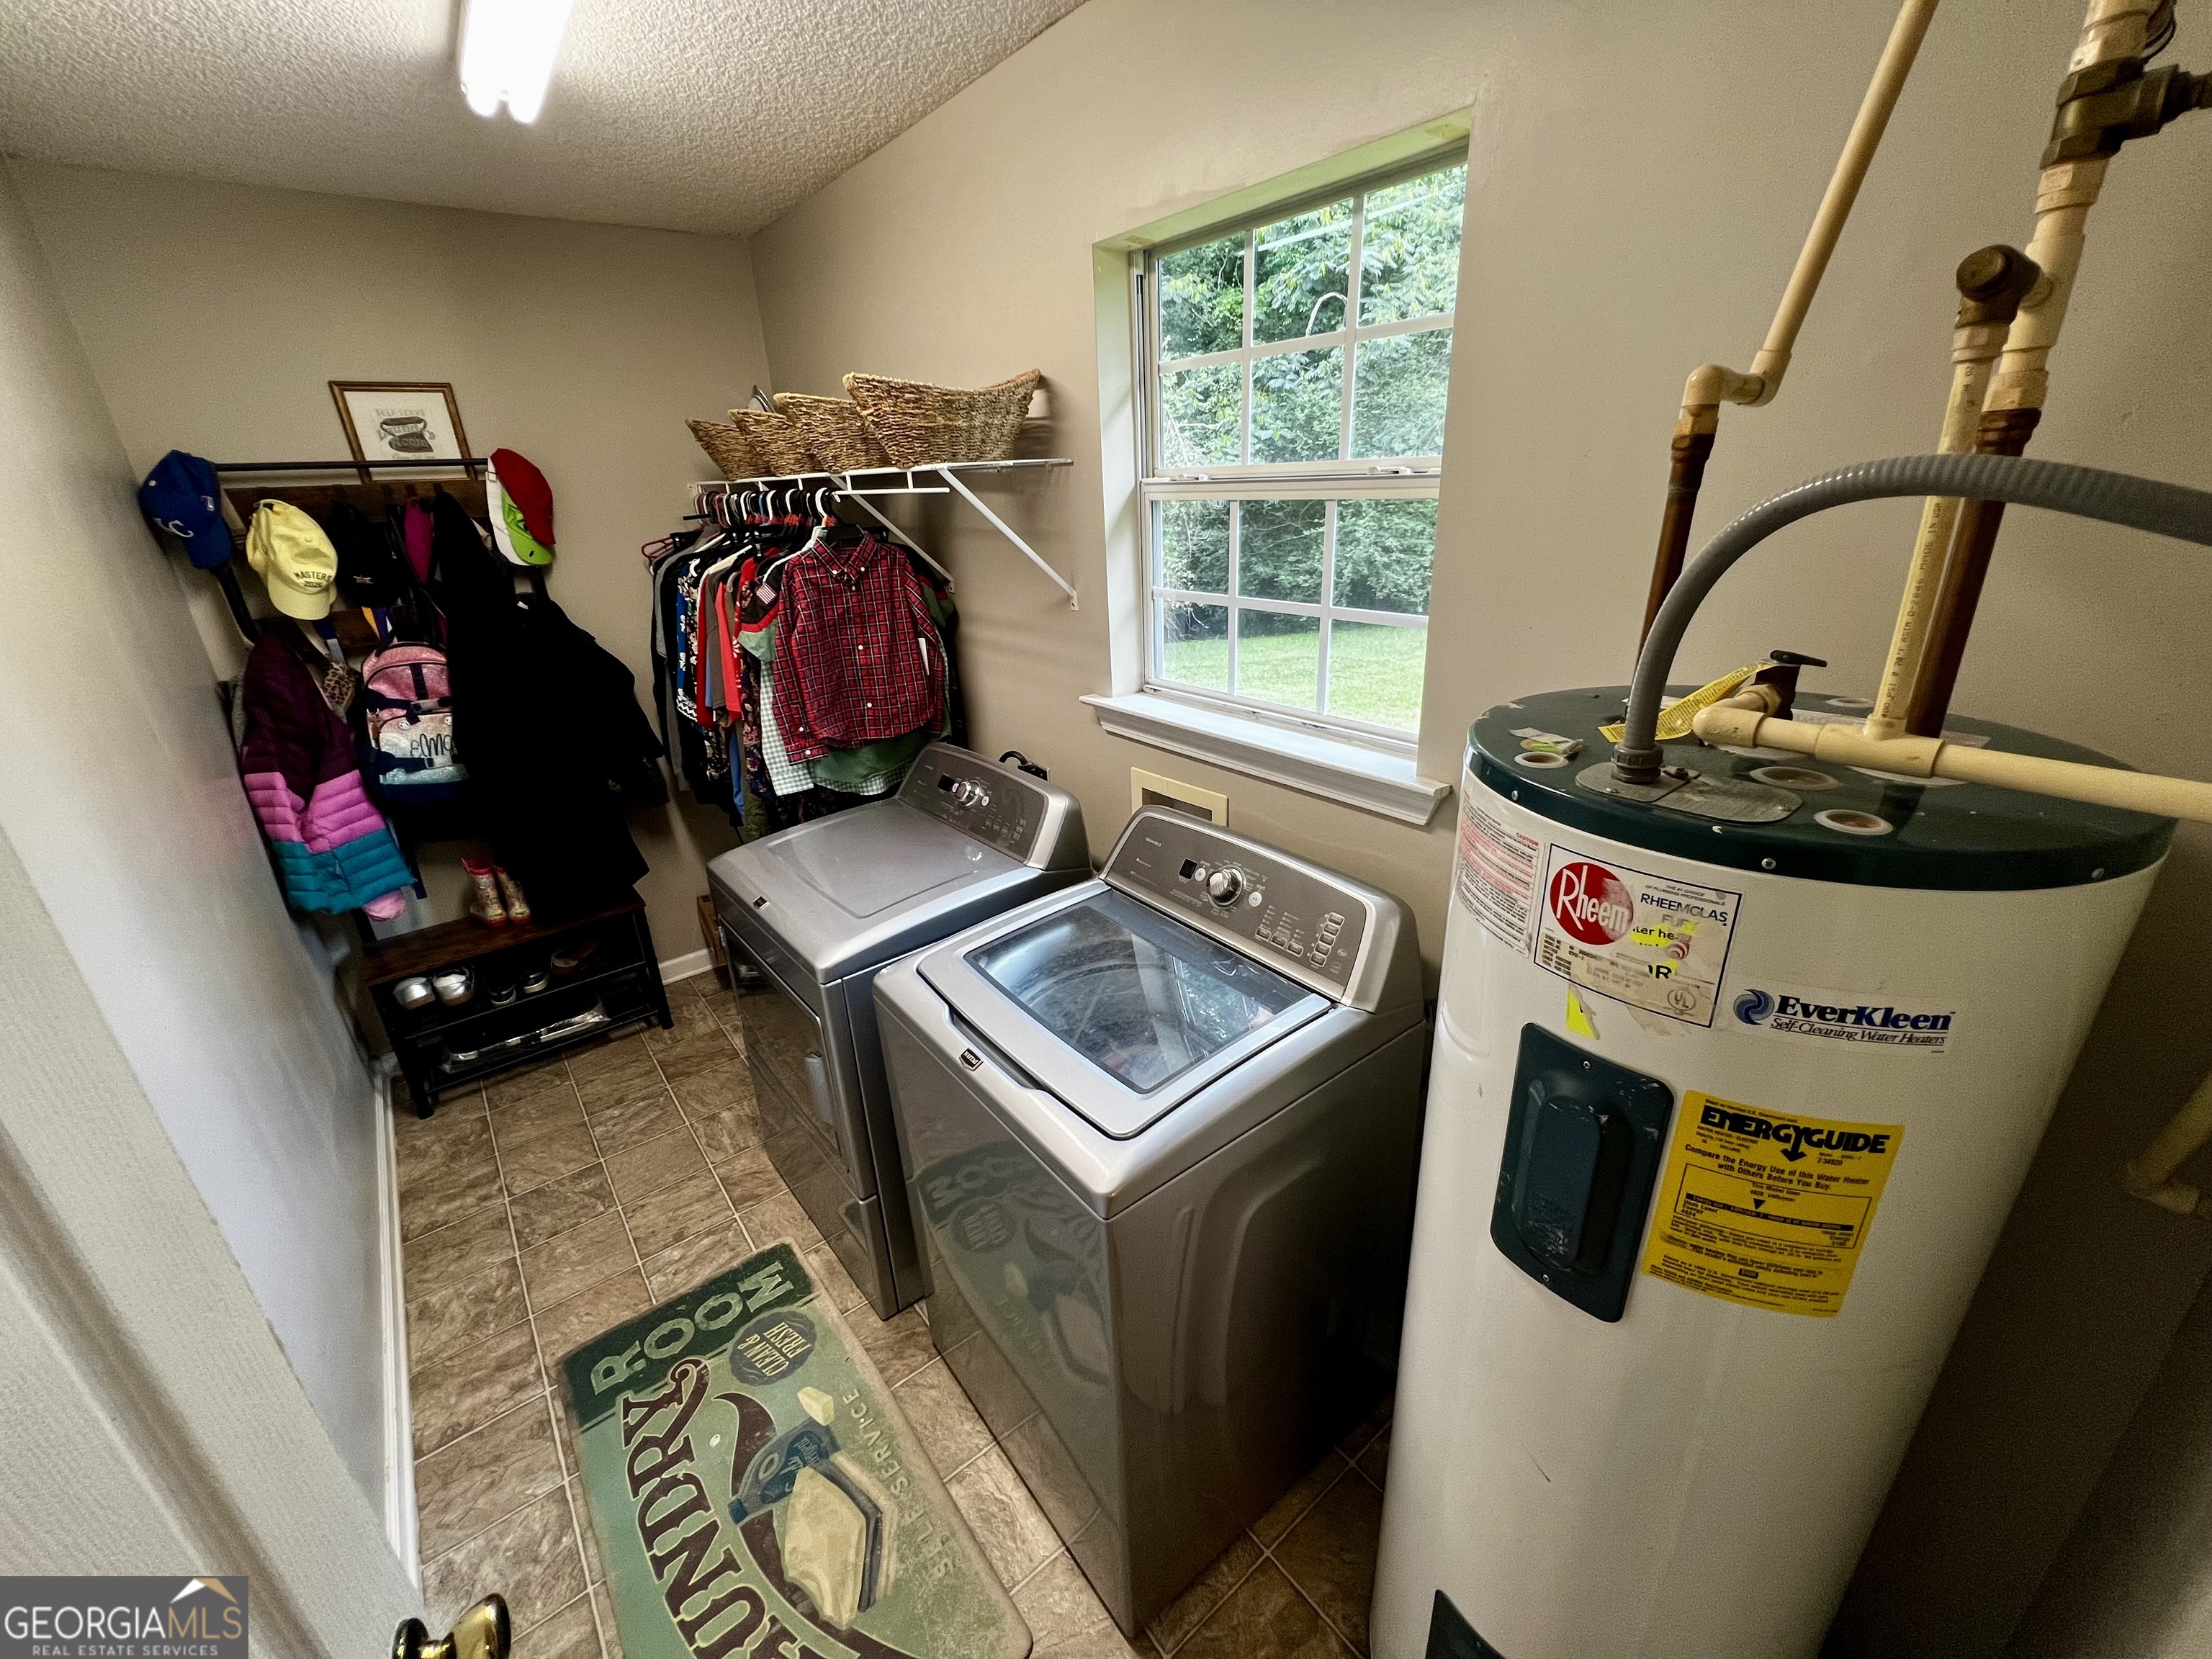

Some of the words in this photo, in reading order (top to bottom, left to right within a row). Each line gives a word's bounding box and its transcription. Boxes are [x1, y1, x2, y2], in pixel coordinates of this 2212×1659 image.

[1932, 503, 1943, 518] USA
[1928, 522, 1937, 534] IN
[1920, 541, 1933, 570] MADE
[293, 571, 332, 582] MASTERS
[1556, 865, 1629, 933] Rheem
[1681, 893, 1725, 906] PROFESSIONALS
[1674, 992, 1689, 1008] UL
[1775, 995, 1951, 1030] EverKleen
[1771, 1017, 1858, 1040] Self-Cleaning
[1860, 1030, 1897, 1043] Water
[1898, 1033, 1946, 1044] Heaters
[1700, 1104, 1890, 1154] ENERGYGUIDE
[1685, 1143, 1720, 1160] Compare
[1723, 1155, 1736, 1164] the
[1738, 1159, 1768, 1172] Energy
[1770, 1165, 1785, 1174] Use
[1798, 1171, 1814, 1179] this
[1817, 1173, 1841, 1183] Water
[1843, 1176, 1870, 1185] Heater
[1717, 1163, 1735, 1172] with
[1737, 1166, 1764, 1179] Others
[1766, 1173, 1794, 1184] Before
[1797, 1179, 1812, 1187] You
[590, 1261, 794, 1395] ROOM
[737, 1334, 761, 1350] &
[763, 1321, 811, 1359] FRESH
[744, 1341, 789, 1376] CLEAN
[842, 1388, 910, 1496] SERVICE
